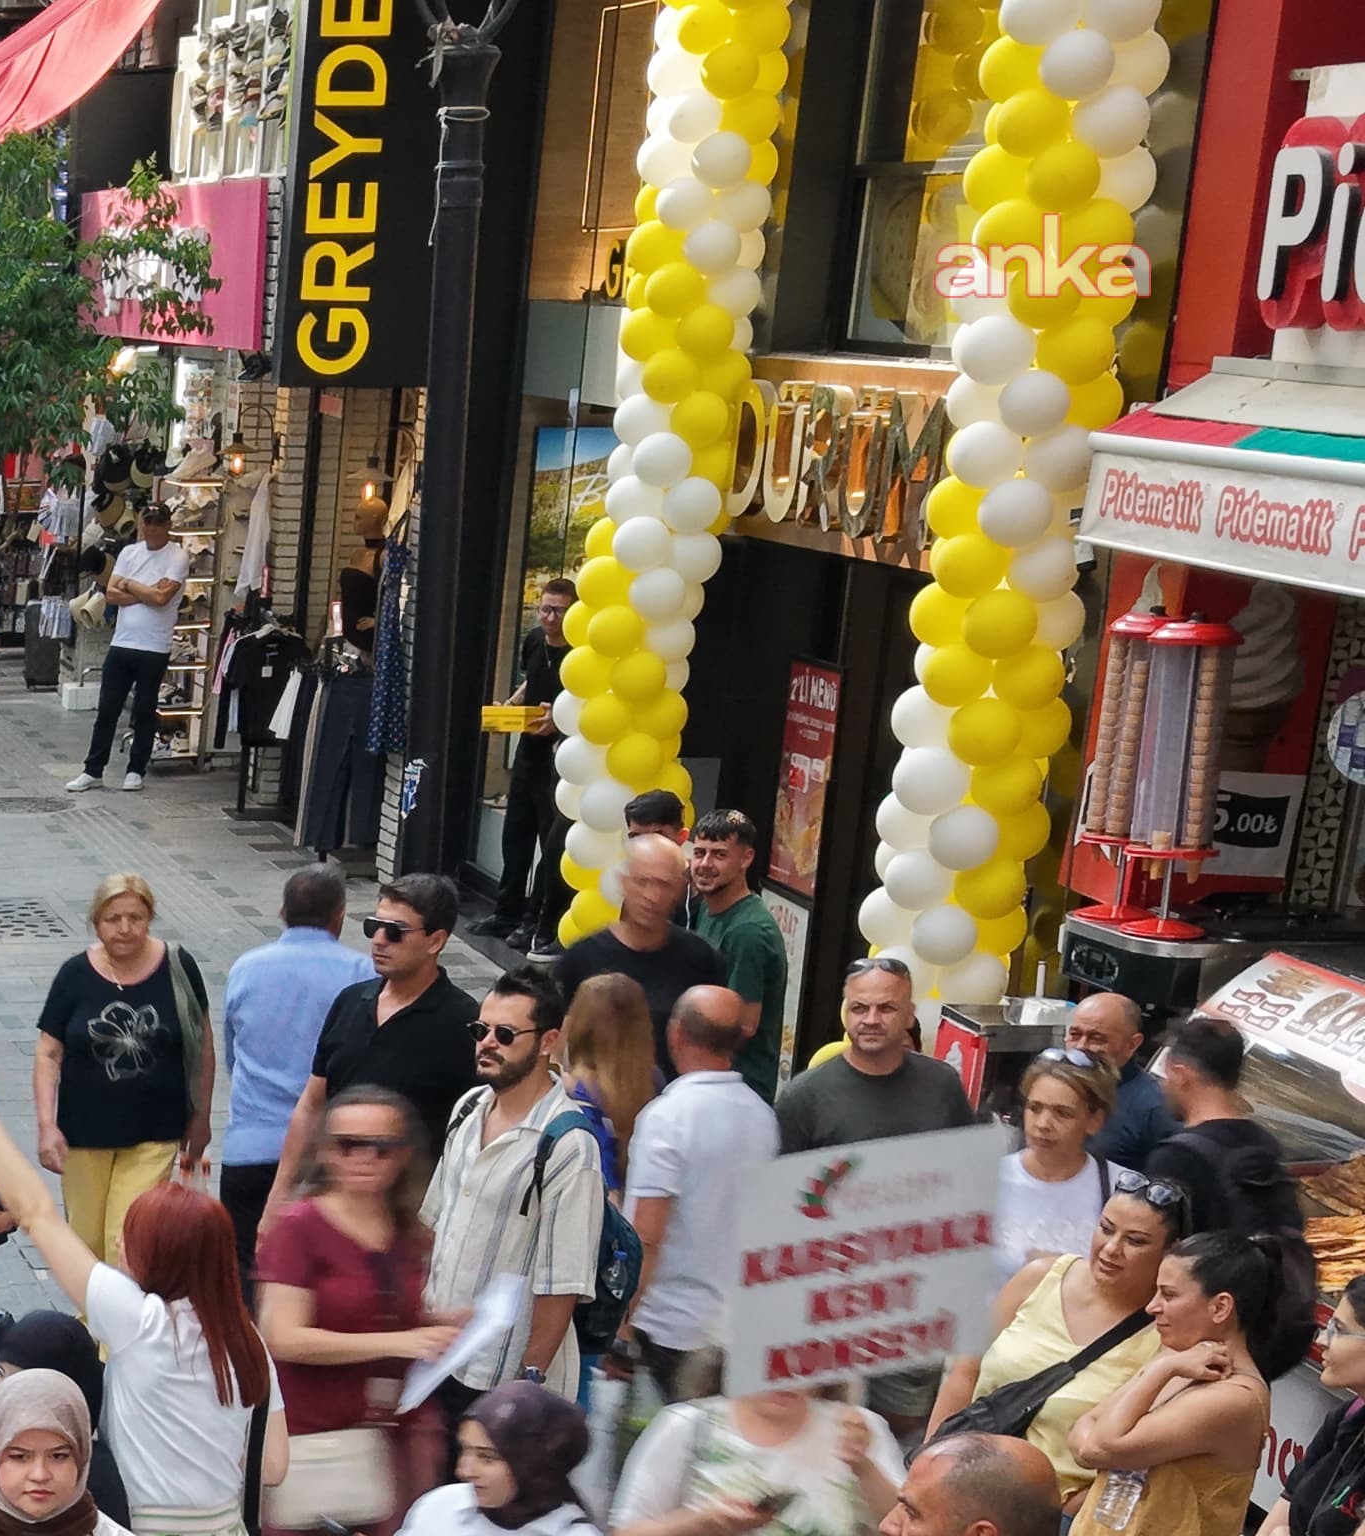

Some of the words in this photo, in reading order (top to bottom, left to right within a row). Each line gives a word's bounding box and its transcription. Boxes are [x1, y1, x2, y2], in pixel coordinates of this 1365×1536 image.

[725, 380, 948, 550] DÜRÜM
[1100, 468, 1204, 534] Pidematik
[1215, 485, 1336, 557] Pidematik
